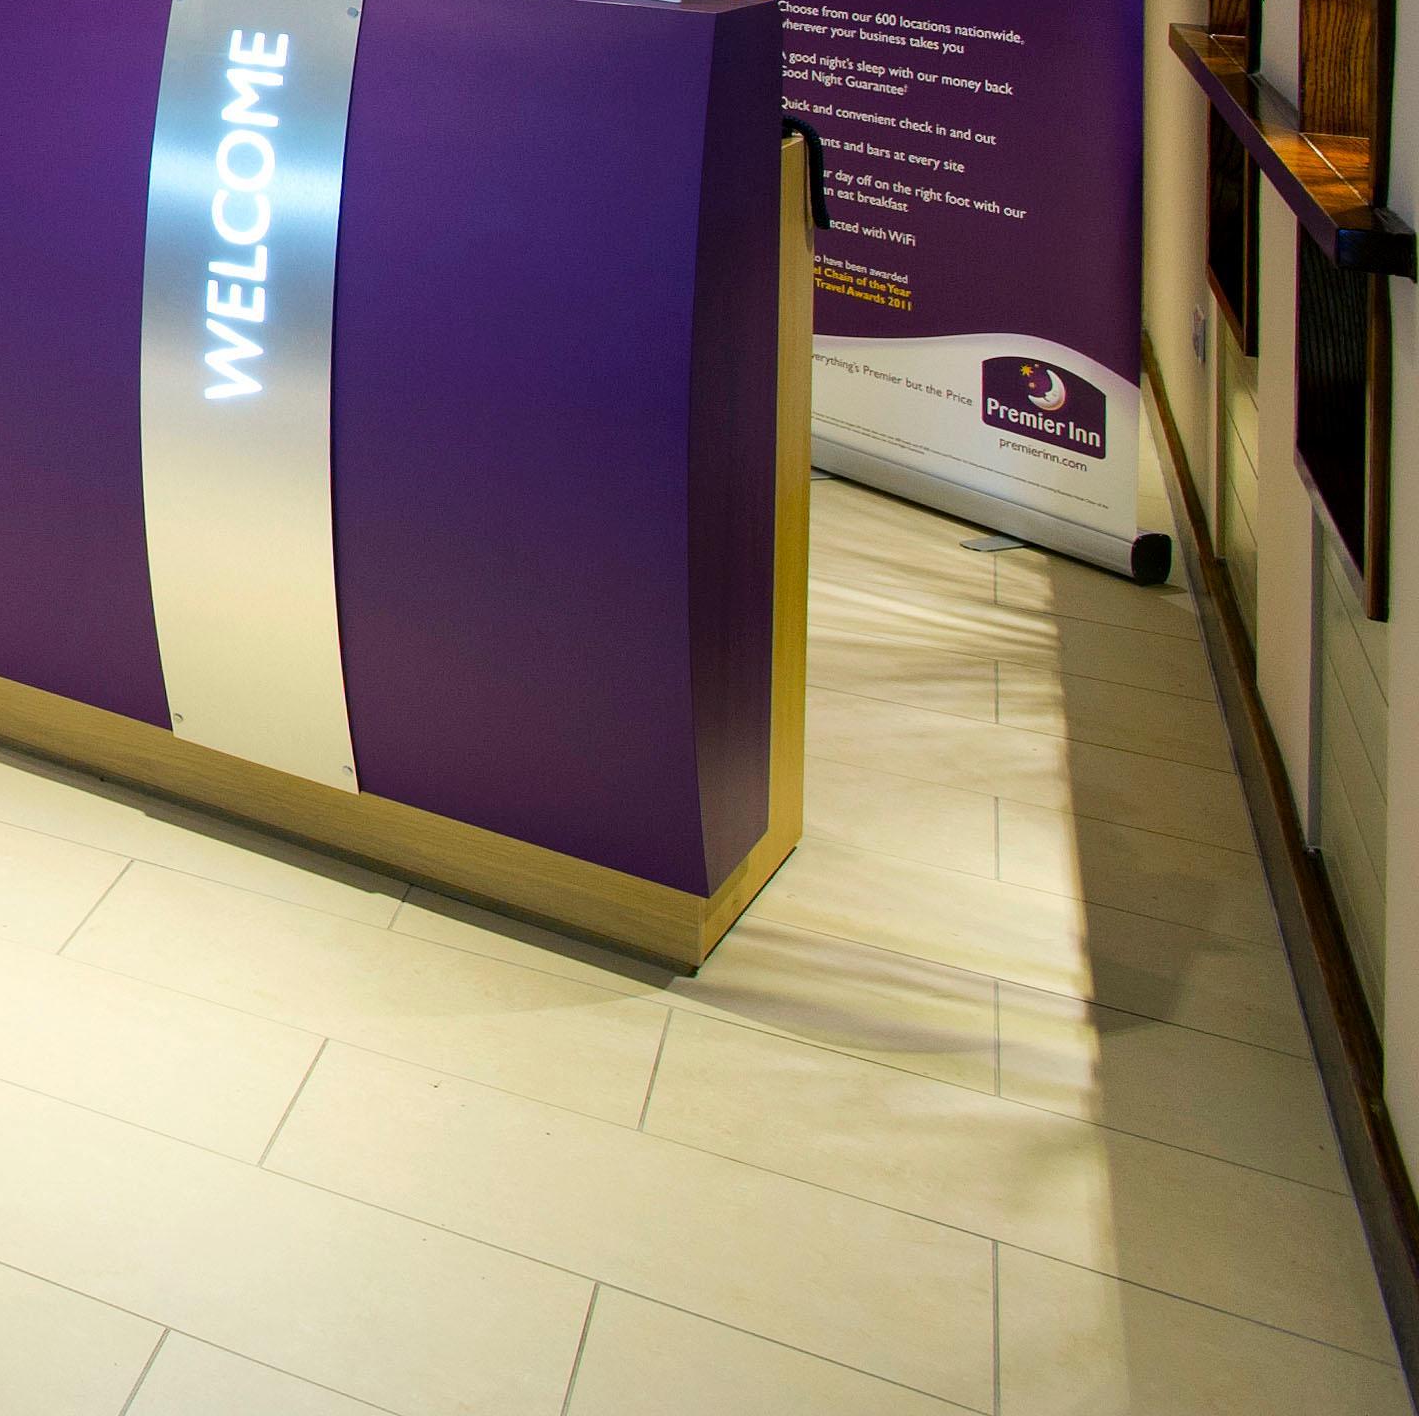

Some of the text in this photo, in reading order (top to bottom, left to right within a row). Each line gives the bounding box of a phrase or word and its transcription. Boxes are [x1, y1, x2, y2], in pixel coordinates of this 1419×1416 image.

[777, 0, 819, 16] Choose
[821, 5, 849, 21] from
[851, 12, 873, 23] our
[874, 13, 897, 26] 600
[899, 15, 952, 34] locations
[830, 26, 857, 39] your
[859, 28, 907, 46] business
[909, 35, 940, 51] takes
[942, 42, 965, 55] you
[788, 52, 816, 65] good
[819, 55, 854, 70] night's
[856, 60, 886, 77] sleep
[888, 66, 914, 80] with
[916, 71, 940, 83] our
[941, 75, 982, 93] money
[984, 79, 1014, 96] back
[811, 69, 843, 87] Night
[812, 104, 833, 115] and
[835, 108, 896, 127] convenient
[899, 117, 933, 134] check
[935, 124, 947, 136] in
[949, 128, 972, 141] and
[974, 133, 997, 145] out
[843, 141, 864, 153] and
[866, 143, 891, 159] bars
[893, 151, 906, 162] at
[908, 153, 941, 171] every
[943, 159, 966, 173] site
[834, 169, 854, 186] day
[856, 174, 873, 187] off
[874, 179, 890, 191] on
[892, 181, 912, 195] the
[915, 186, 942, 203] right
[945, 191, 971, 208] foot
[973, 200, 1000, 214] with
[1003, 207, 1028, 219] our
[837, 189, 855, 201] eat
[857, 191, 910, 212] breakfast
[202, 27, 290, 401] WELCOME
[861, 226, 916, 247] with WiFi
[823, 254, 844, 268] have
[845, 260, 868, 274] been
[869, 268, 909, 284] awarded
[824, 267, 854, 284] Chain
[855, 277, 868, 287] of
[868, 279, 887, 292] the
[886, 282, 912, 298] Year
[815, 277, 913, 312] Travel Awards 2011
[862, 364, 902, 385] Premier
[905, 376, 923, 392] but
[925, 385, 943, 398] the
[945, 389, 973, 407] Price
[986, 396, 1101, 448] Premier Inn
[999, 437, 1088, 473] premierinn.com
